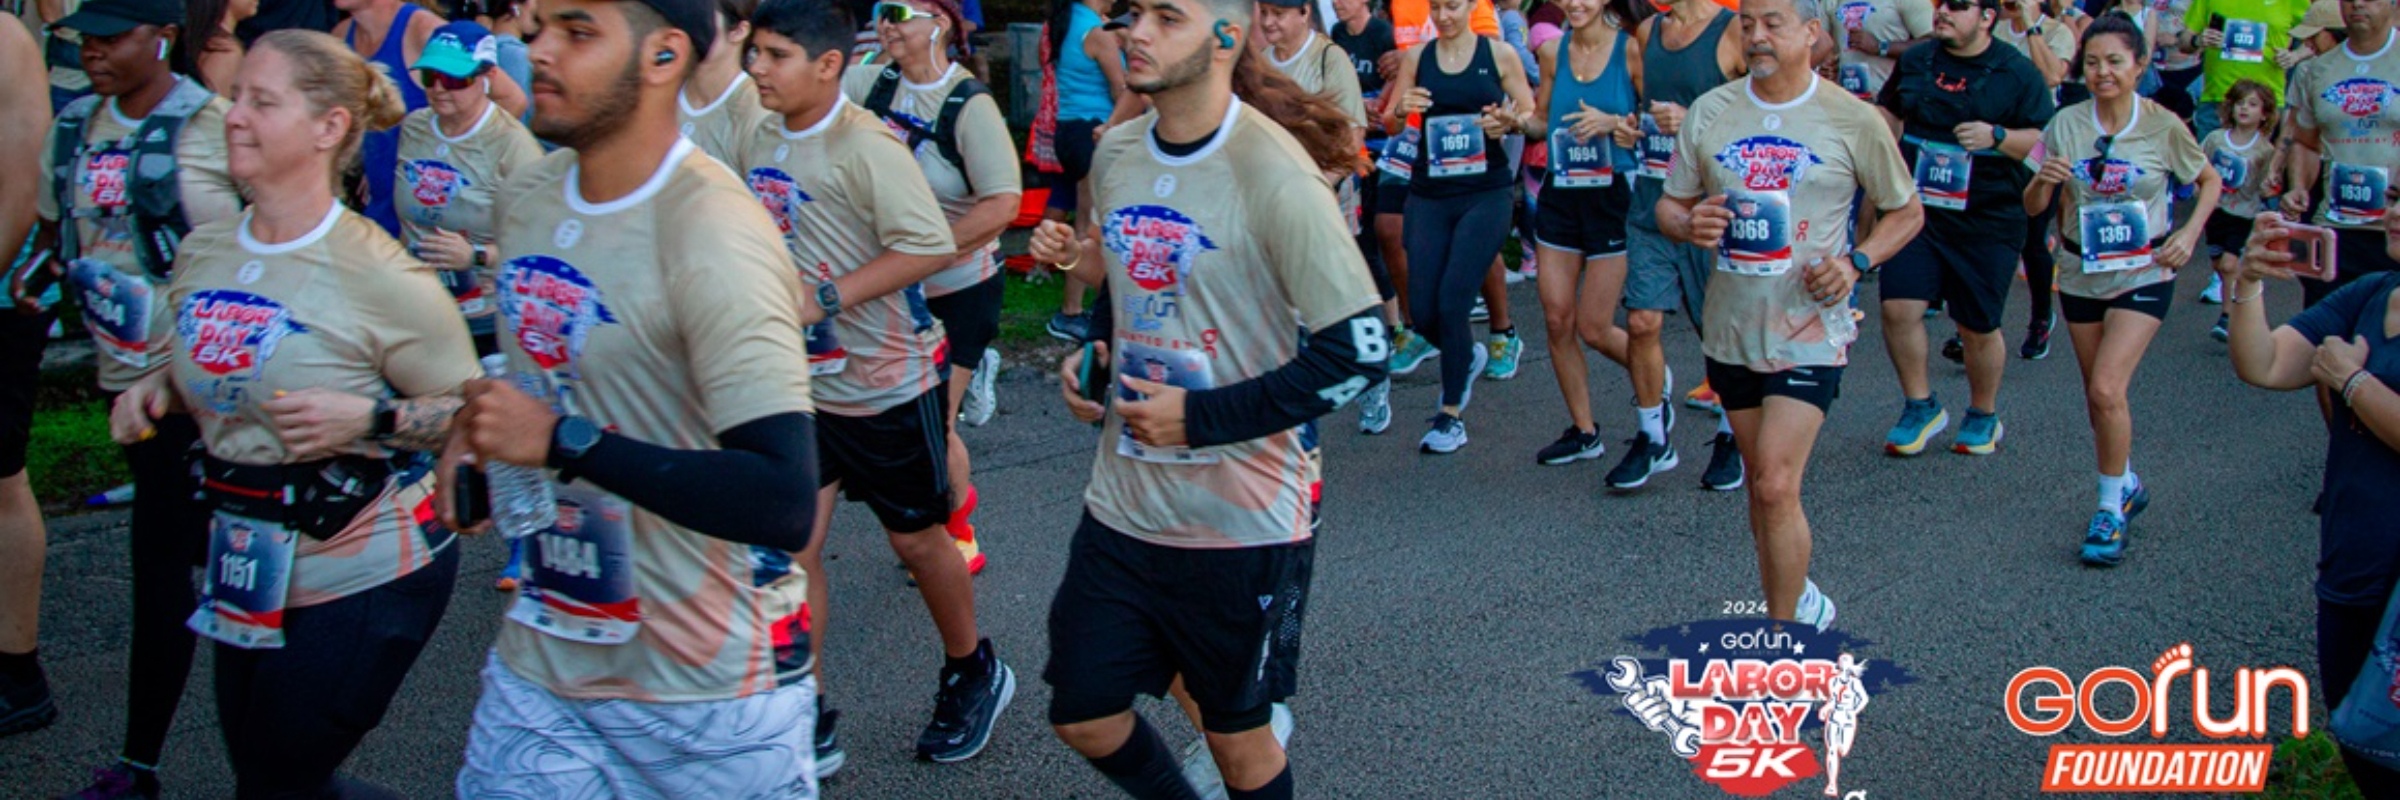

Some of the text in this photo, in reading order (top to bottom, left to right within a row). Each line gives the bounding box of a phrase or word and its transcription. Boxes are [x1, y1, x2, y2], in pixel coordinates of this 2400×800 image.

[1441, 134, 1470, 152] 1697
[1567, 146, 1598, 163] 1694
[1740, 145, 1799, 161] LABOR
[1121, 214, 1187, 244] LABOR
[1730, 218, 1770, 242] 1368
[1131, 261, 1172, 283] 5K
[193, 298, 275, 327] LABOR
[199, 322, 252, 346] DAY
[195, 344, 249, 369] 5K
[536, 531, 602, 580] 1484
[219, 551, 259, 592] 1151
